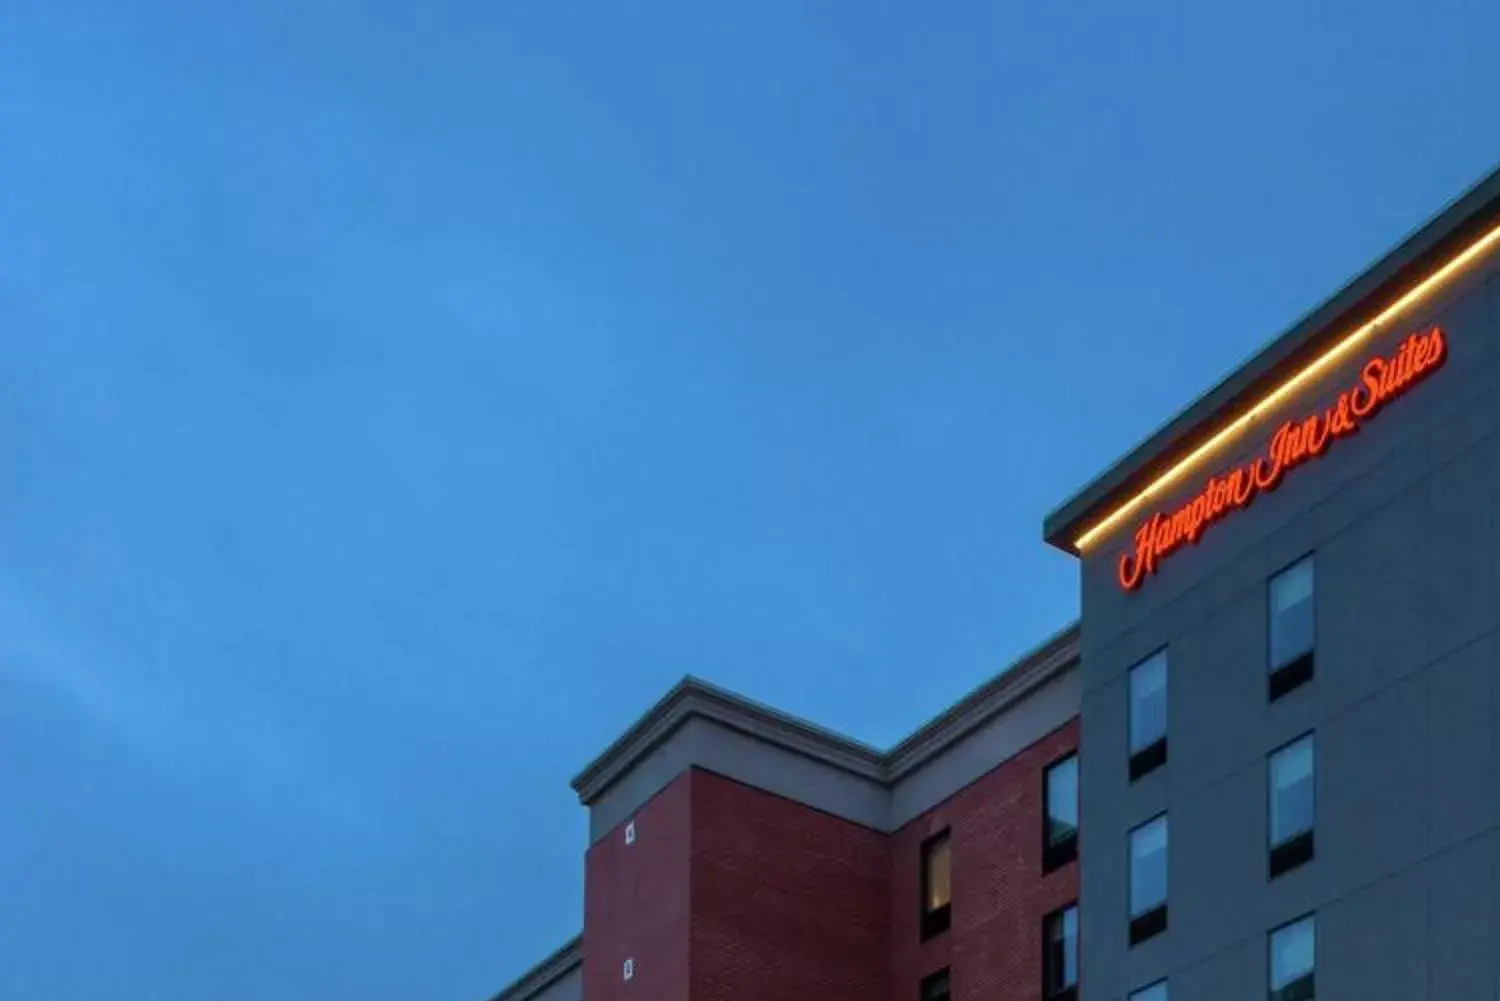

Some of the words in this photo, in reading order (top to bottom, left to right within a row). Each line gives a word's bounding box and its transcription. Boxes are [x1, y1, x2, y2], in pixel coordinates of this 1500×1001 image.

[1119, 466, 1255, 590] Hampton
[1255, 409, 1332, 488] Inn
[1329, 394, 1355, 434] &
[1351, 326, 1447, 416] Suites
